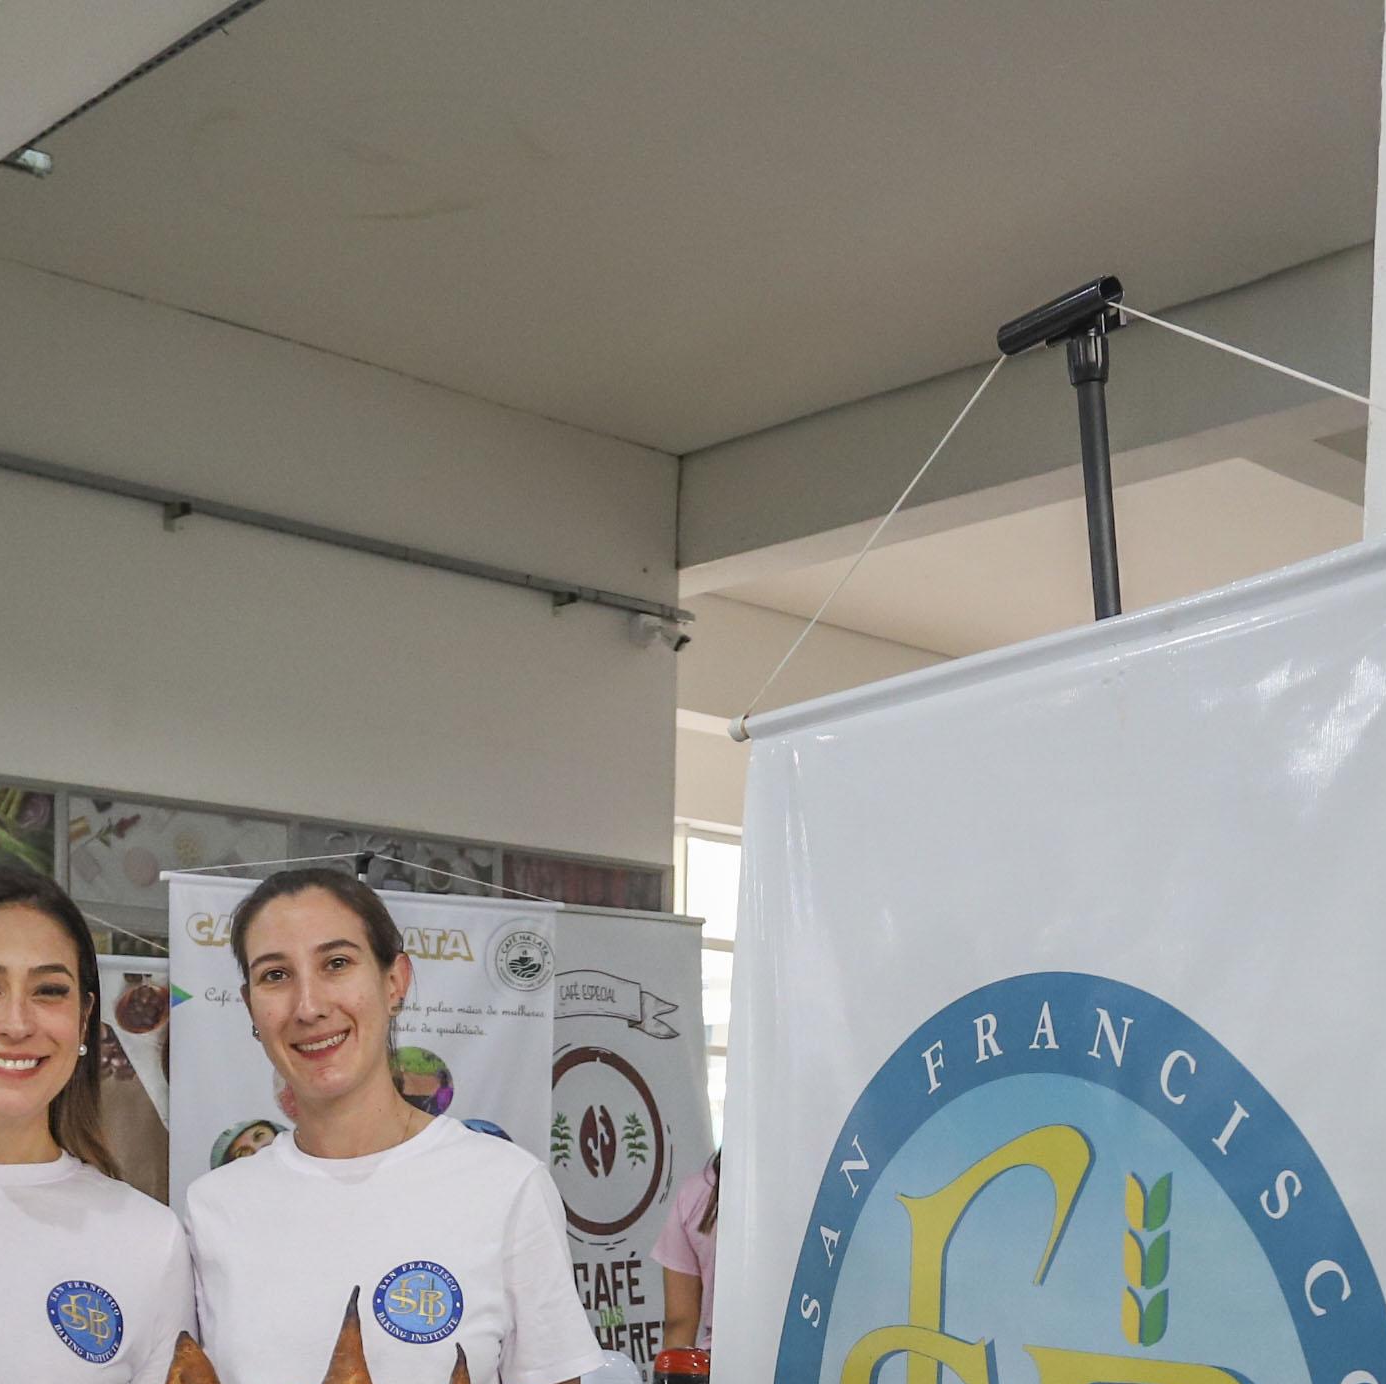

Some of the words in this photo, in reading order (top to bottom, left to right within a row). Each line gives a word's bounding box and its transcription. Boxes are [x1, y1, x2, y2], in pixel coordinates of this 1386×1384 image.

[400, 926, 475, 961] ATA
[559, 981, 581, 1000] CAFÉ
[582, 983, 616, 1003] ESPECIAL
[800, 1136, 870, 1328] SAN
[378, 1271, 397, 1291] SAN
[401, 1262, 459, 1293] FRANCISCO
[573, 1251, 645, 1311] CAFÉ
[67, 1281, 120, 1316] FRANCISCO
[54, 1323, 84, 1356] BAKING
[376, 1311, 407, 1338] BAKING
[411, 1317, 459, 1343] INSTITUTE
